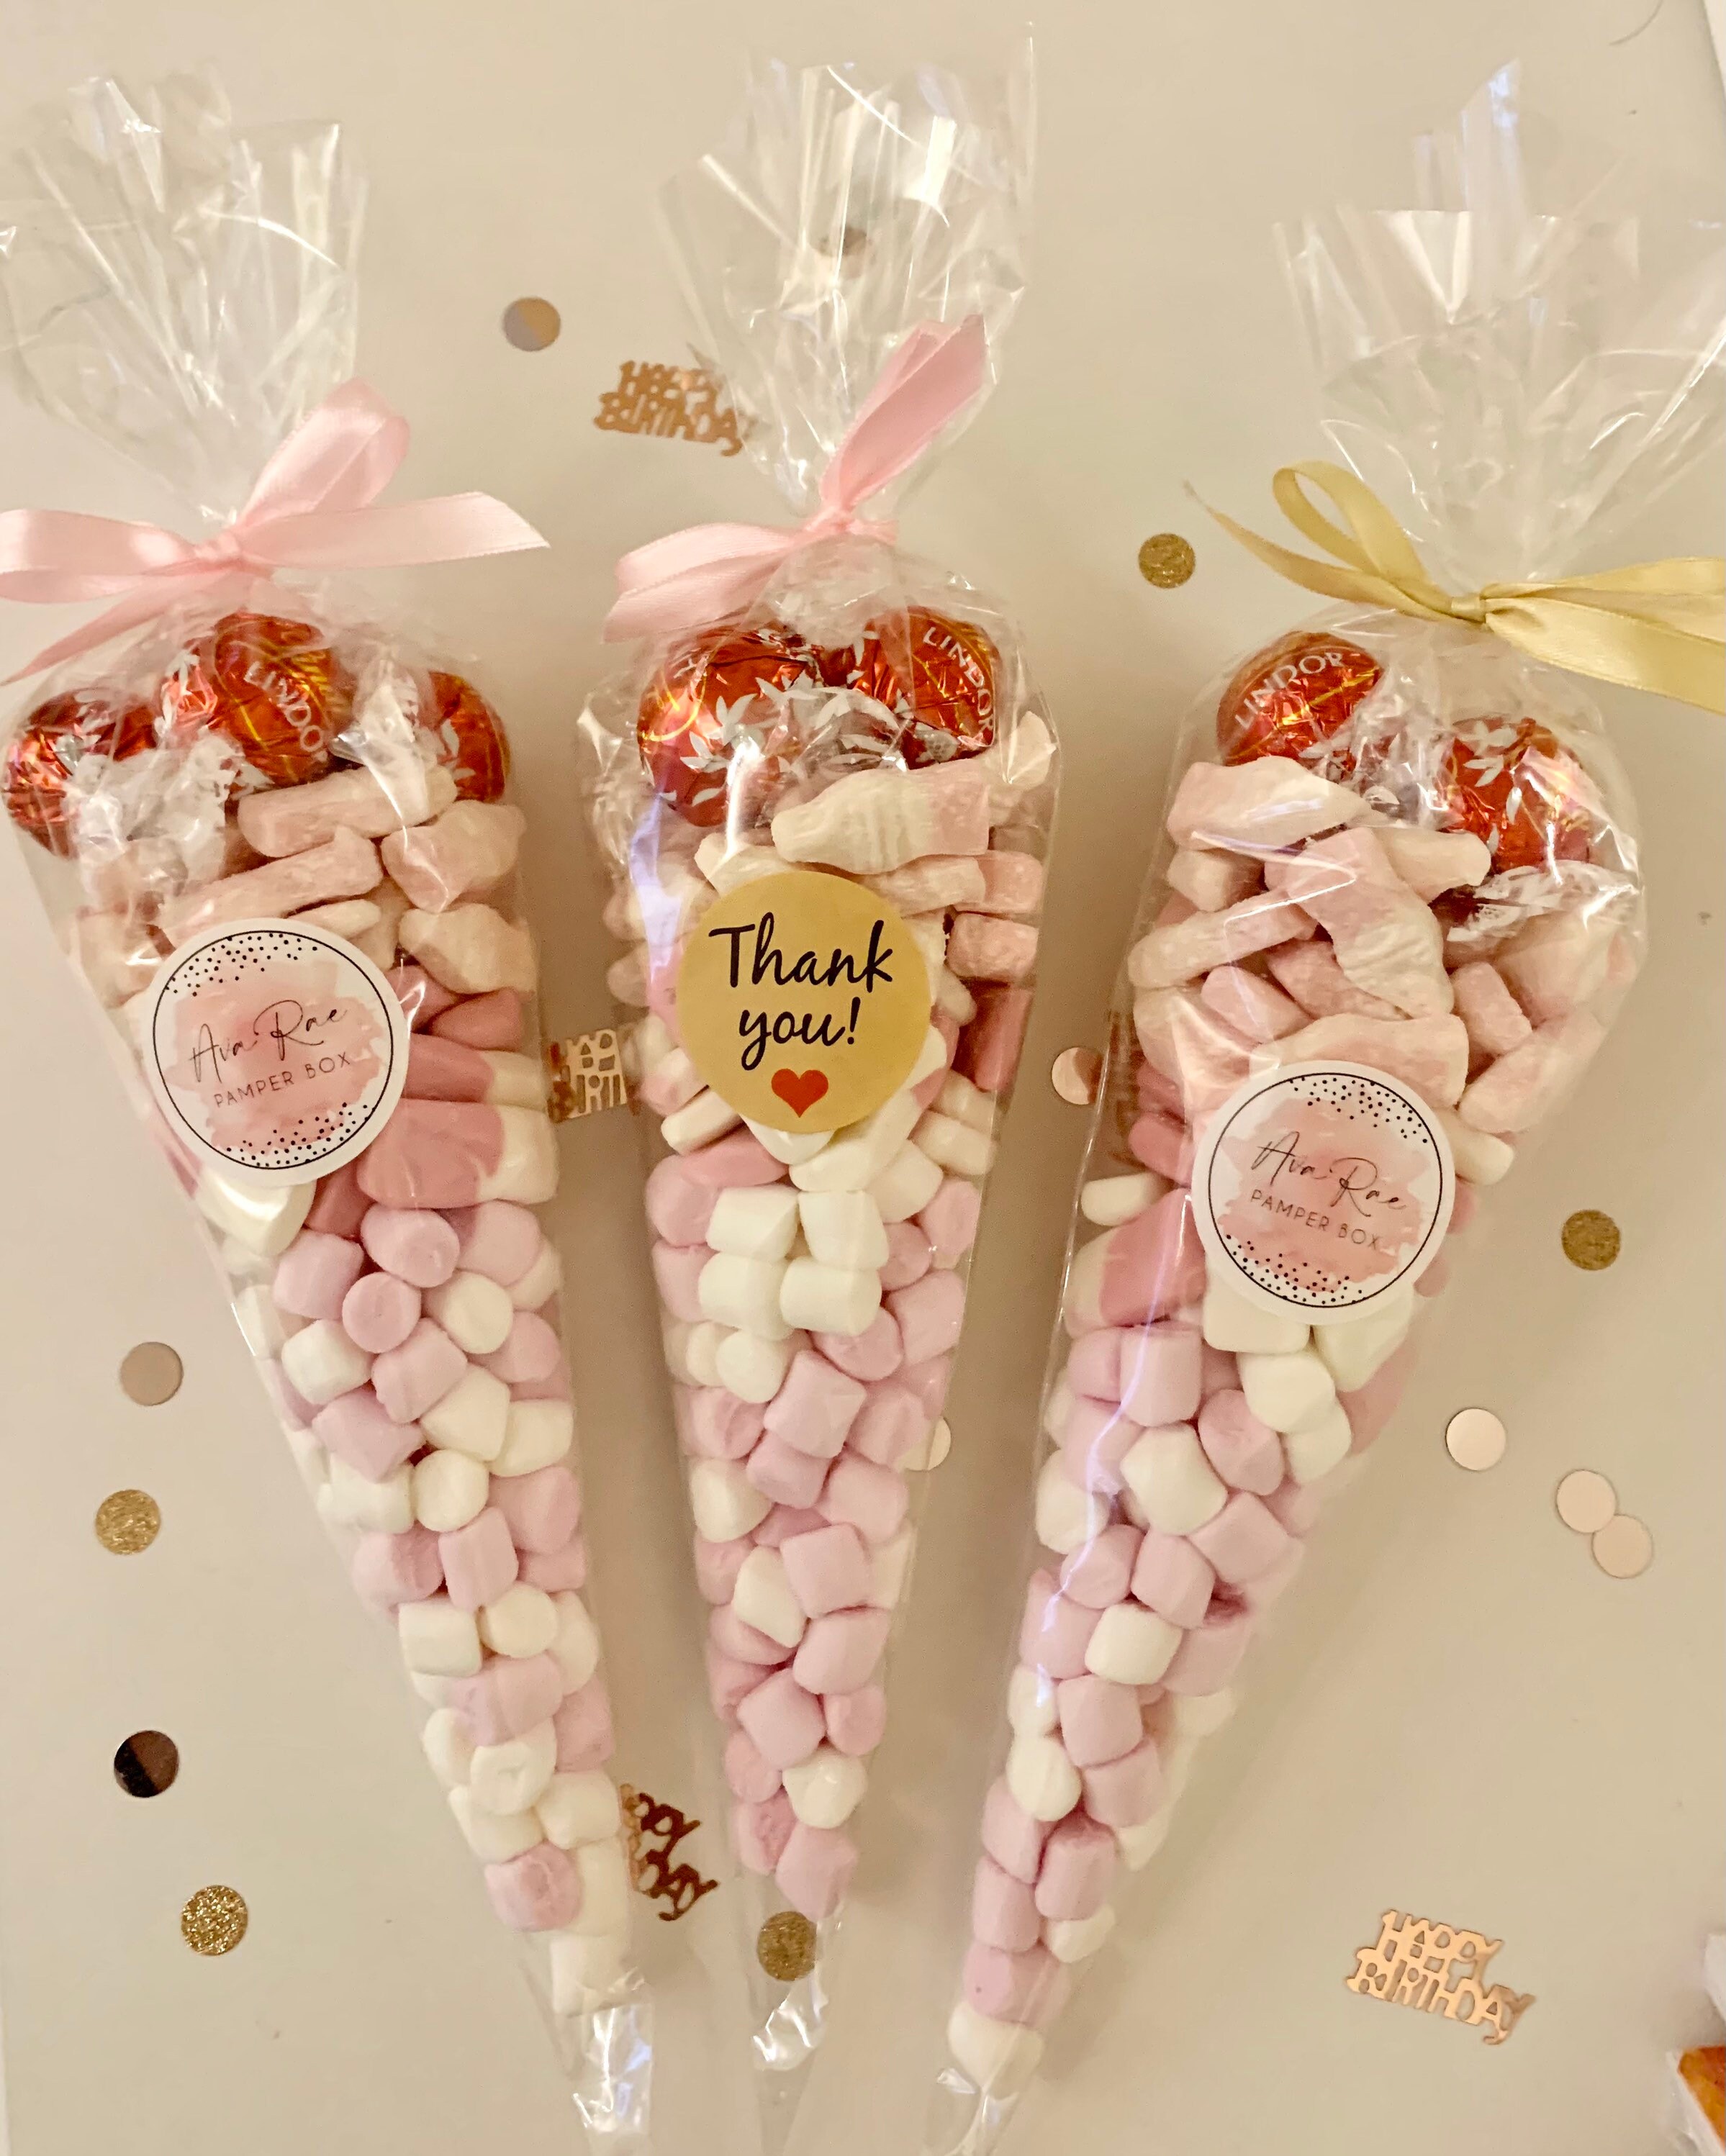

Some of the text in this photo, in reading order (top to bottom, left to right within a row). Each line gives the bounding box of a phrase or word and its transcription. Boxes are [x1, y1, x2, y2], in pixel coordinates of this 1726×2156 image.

[1234, 651, 1345, 730] LINDOR
[708, 911, 893, 993] Thank
[188, 1000, 347, 1084] Ava Rae
[738, 996, 861, 1071] you!
[214, 1051, 352, 1108] PAMPER BOX
[1250, 1131, 1407, 1218] Ava Rae
[1250, 1189, 1381, 1251] PAMPER BOX
[1376, 1908, 1505, 1985] HAPPY
[1345, 1946, 1536, 2045] BIRTHDAY
